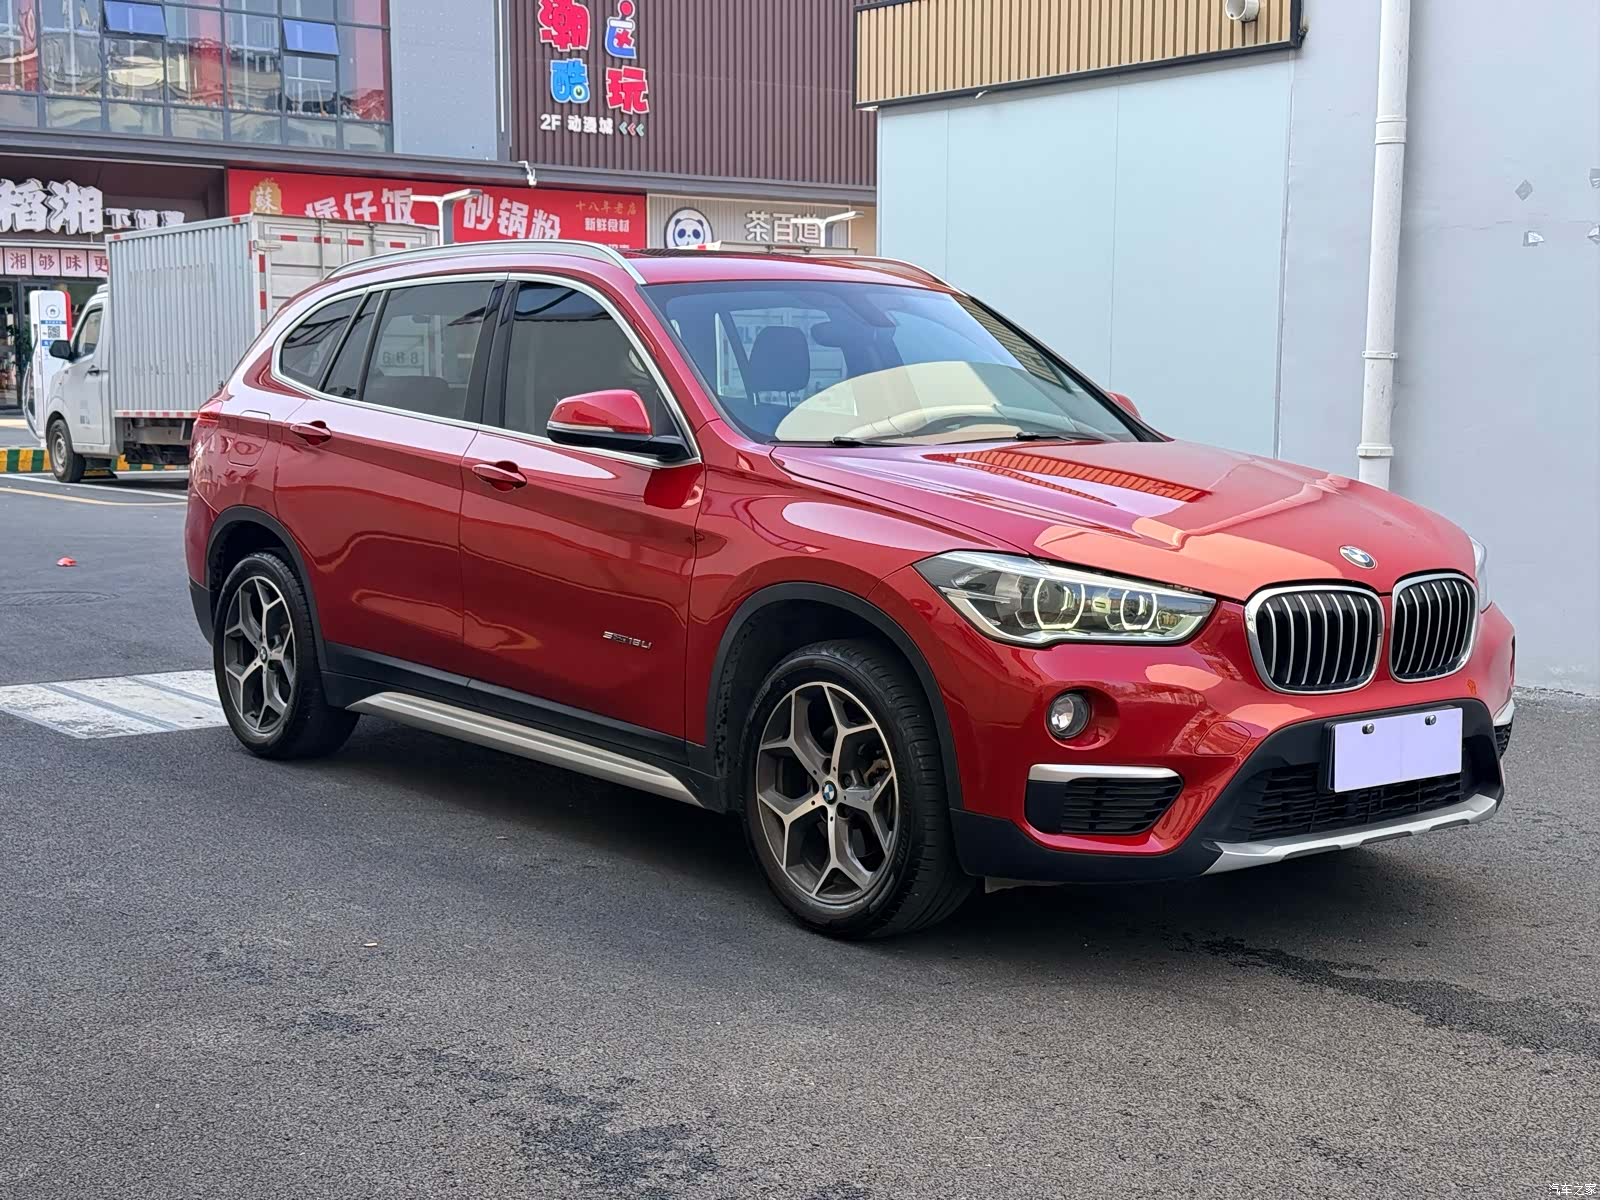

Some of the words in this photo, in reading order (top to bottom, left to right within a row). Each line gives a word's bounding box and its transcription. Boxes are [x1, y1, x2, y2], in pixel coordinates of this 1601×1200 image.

[540, 114, 561, 131] 2F
[576, 200, 637, 216] 十八年老店
[463, 194, 561, 240] 砂锅粉
[584, 217, 630, 233] 新鲜食材
[745, 211, 820, 243] 茶百道
